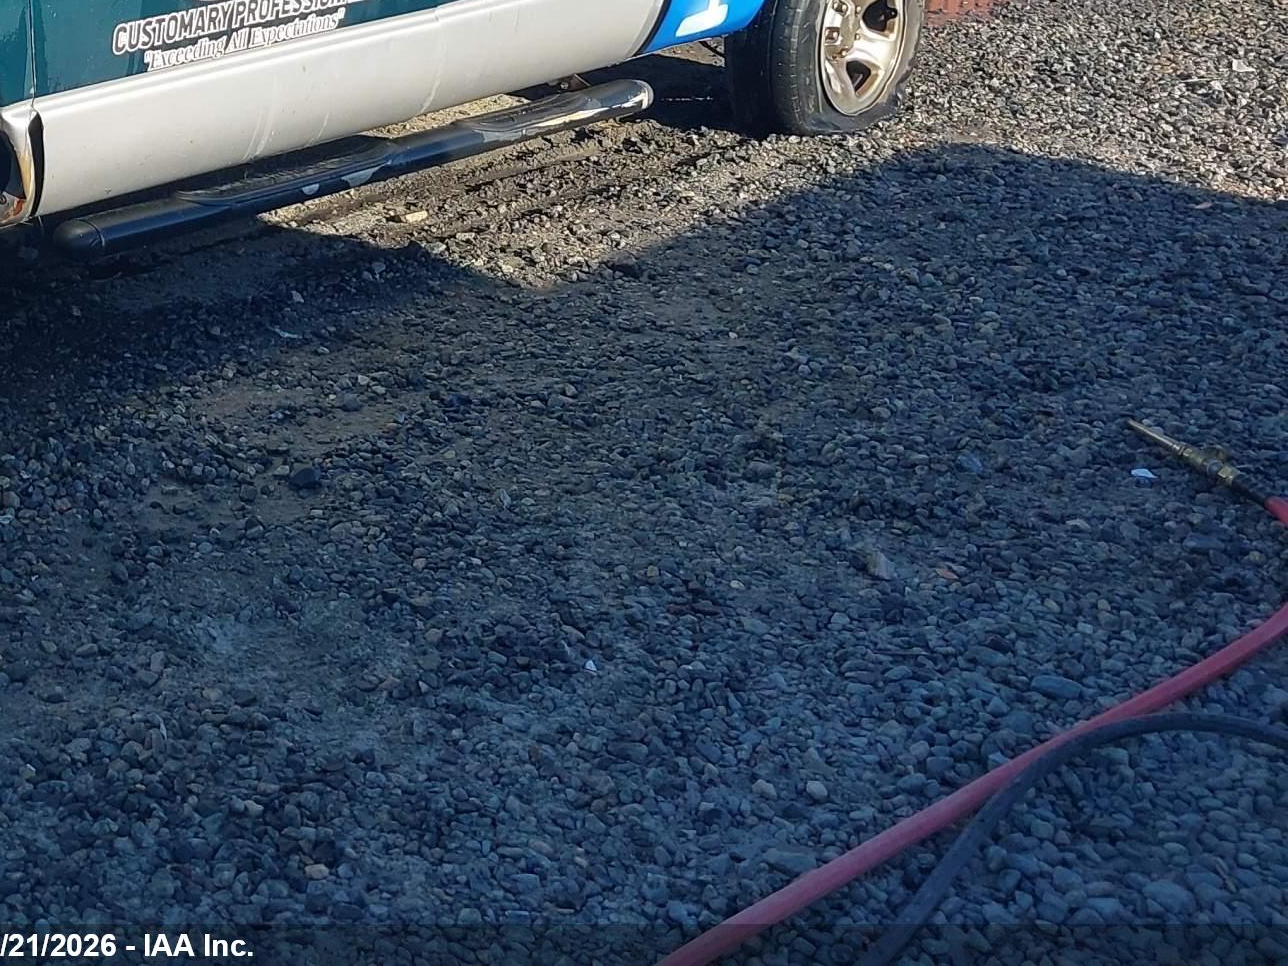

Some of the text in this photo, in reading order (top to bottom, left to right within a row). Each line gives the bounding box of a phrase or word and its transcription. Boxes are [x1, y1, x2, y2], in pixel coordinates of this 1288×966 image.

[113, 2, 231, 54] CUSTOMARY
[144, 7, 346, 71] "Exceeding All Expectations"
